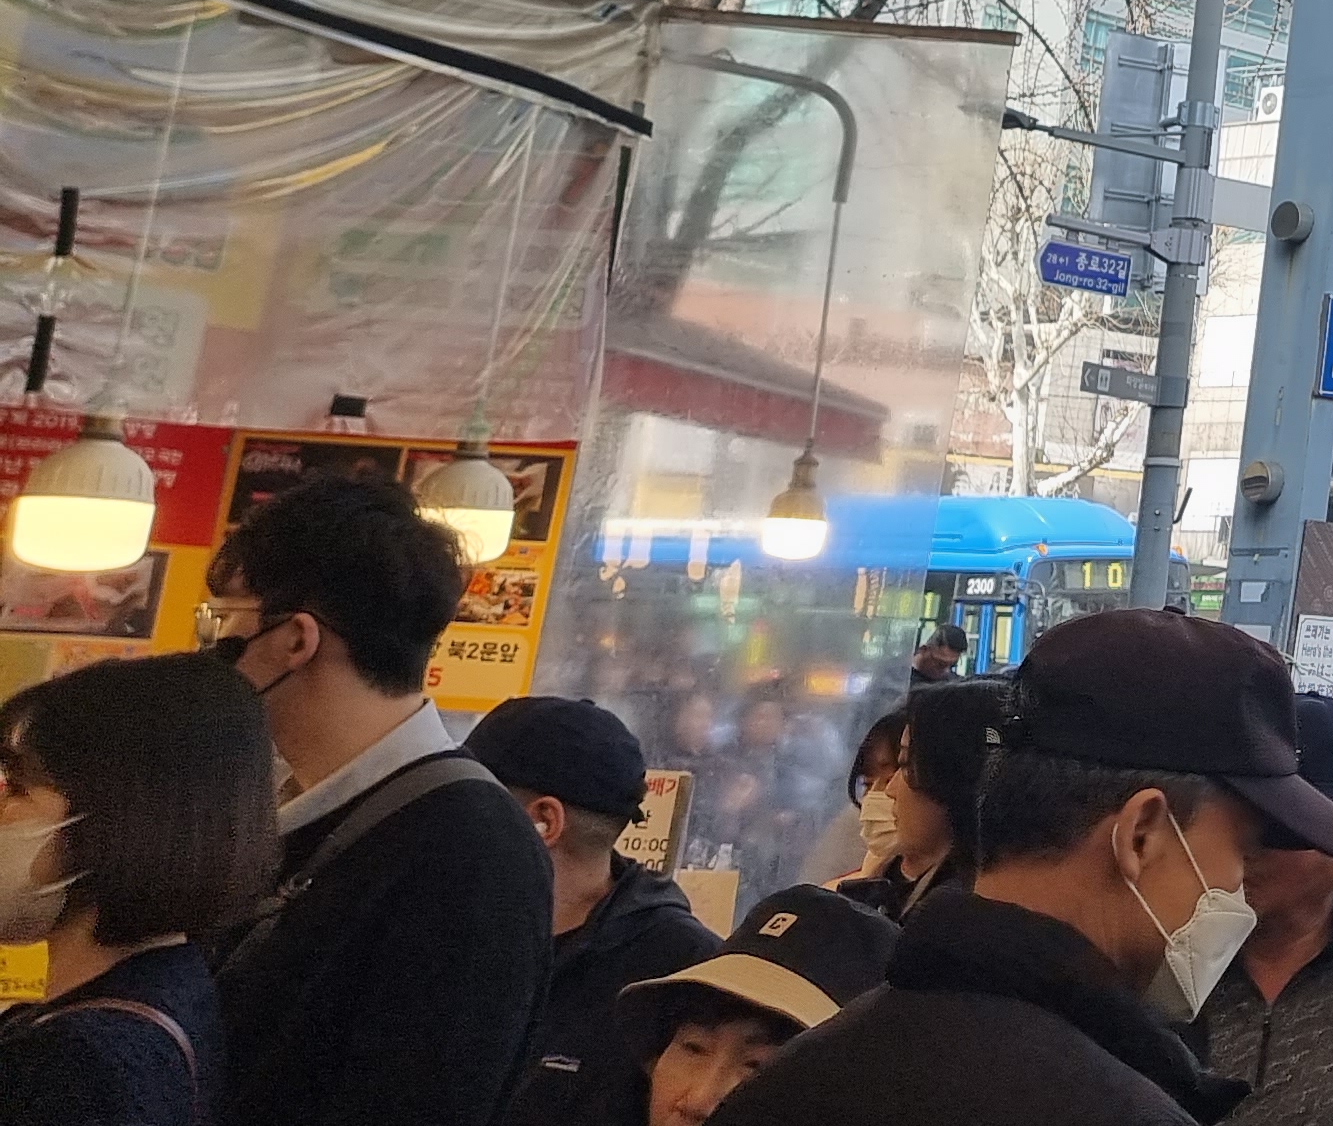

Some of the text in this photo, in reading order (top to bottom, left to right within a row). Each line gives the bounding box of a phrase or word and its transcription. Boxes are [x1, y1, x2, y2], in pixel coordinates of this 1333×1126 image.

[1076, 252, 1128, 279] 종로32길
[1054, 269, 1125, 294] Jong-ro 32-gil
[966, 577, 995, 595] 2300
[1304, 624, 1331, 641] 쓰레기는
[448, 641, 520, 664] 북2문앞
[1301, 643, 1322, 658] Here's
[622, 837, 670, 852] 10:00
